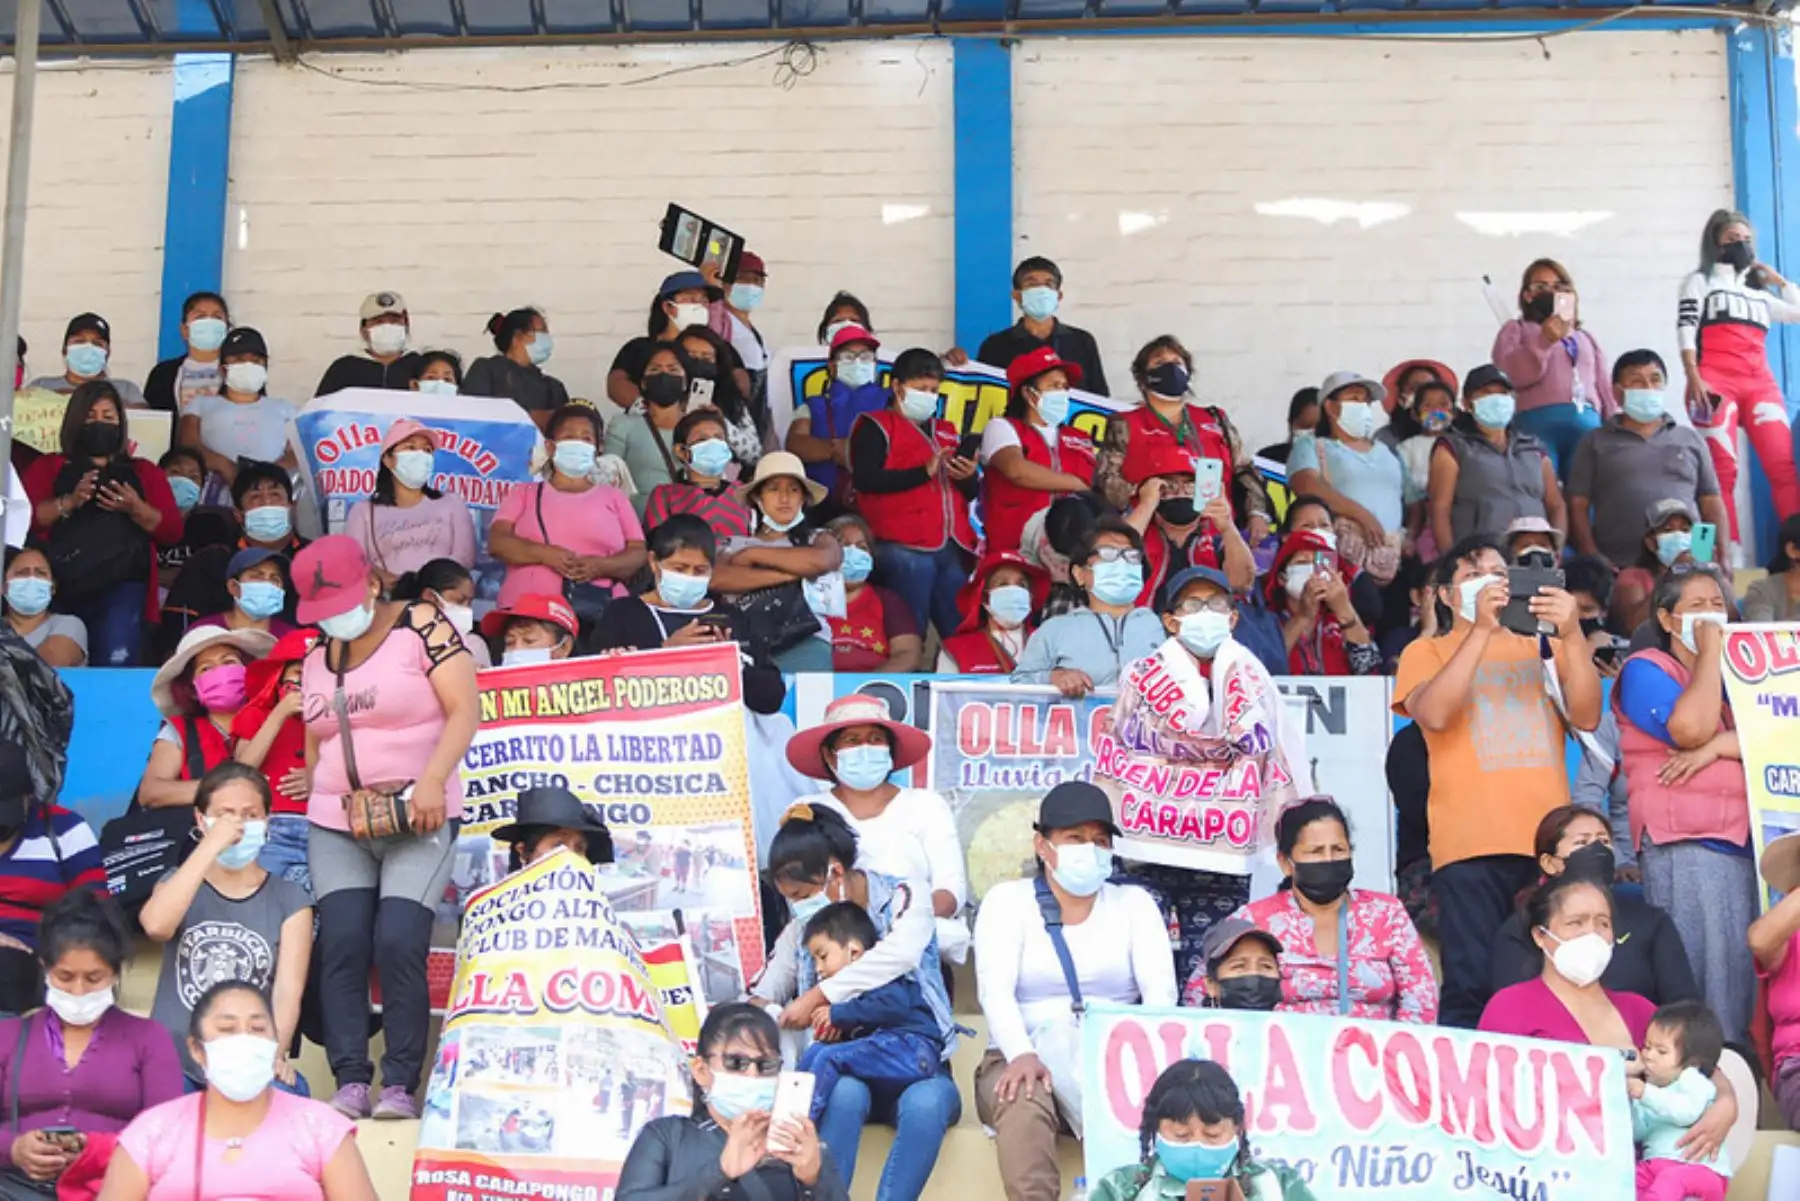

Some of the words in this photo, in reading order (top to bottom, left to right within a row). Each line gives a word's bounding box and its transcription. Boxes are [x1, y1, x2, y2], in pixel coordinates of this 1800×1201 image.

[315, 424, 381, 464] Olla
[501, 687, 532, 718] MI
[537, 678, 611, 717] ANGEL
[614, 674, 730, 708] PODEROSO
[960, 704, 1077, 757] OLLA
[464, 734, 565, 770] CERRITO
[570, 733, 602, 763] LA
[608, 733, 722, 763] LIBERTAD
[593, 773, 726, 794] CHOSICA
[1174, 769, 1220, 798] DE
[552, 898, 617, 926] ALTO
[535, 927, 569, 949] DE
[1332, 1026, 1607, 1154] COMUN
[1331, 1144, 1436, 1187] Niño
